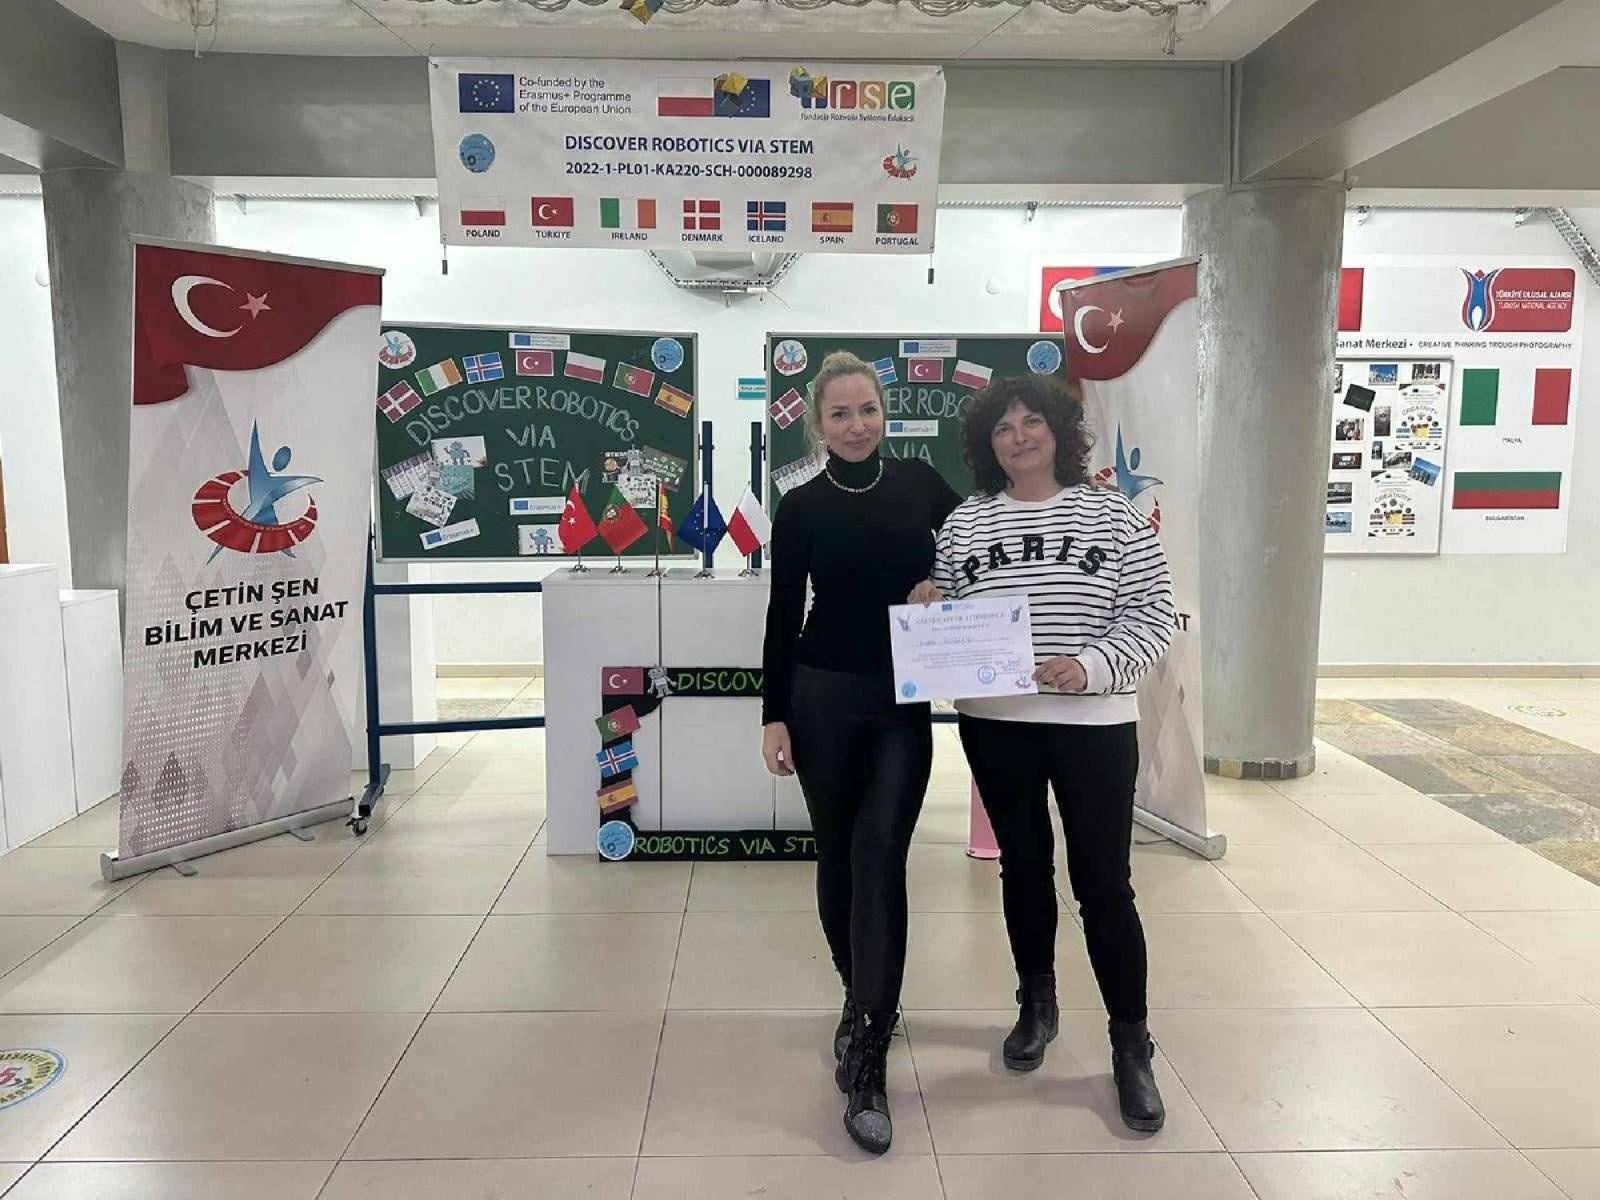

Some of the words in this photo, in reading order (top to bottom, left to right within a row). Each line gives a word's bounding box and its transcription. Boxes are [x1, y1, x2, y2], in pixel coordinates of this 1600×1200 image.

[520, 76, 571, 87] Co-funded
[575, 77, 586, 89] by
[590, 79, 604, 88] the
[520, 89, 570, 100] Erasmus+
[574, 90, 631, 102] Programme
[520, 102, 530, 112] of
[532, 103, 547, 112] the
[551, 103, 599, 114] European
[603, 104, 631, 113] Union
[566, 136, 648, 151] DISCOVER
[652, 138, 734, 153] ROBOTICS
[738, 140, 765, 153] VIA
[770, 140, 814, 154] STEM
[566, 162, 813, 178] 2022-1-PL01-KA220-SCH-000089298
[466, 230, 501, 238] POLAND
[612, 232, 648, 241] IRELAND
[681, 233, 723, 242] DENMARK
[748, 235, 784, 243] ICELAND
[820, 236, 844, 245] SPAIN
[876, 238, 919, 246] PORTUGAL
[1366, 339, 1407, 348] Merkezi
[406, 386, 532, 446] DISCOVER
[536, 386, 640, 441] ROBOTICS
[506, 424, 556, 448] VIA
[495, 458, 591, 496] STEM
[962, 535, 1107, 584] PARIS
[185, 581, 264, 615] ÇETİN
[271, 577, 319, 605] ŞEN
[145, 617, 223, 646] BİLİM
[230, 613, 263, 634] VE
[270, 601, 349, 628] SANAT
[193, 630, 307, 668] MERKEZİ
[634, 836, 730, 854] ROBOTICS
[740, 837, 776, 854] VIA
